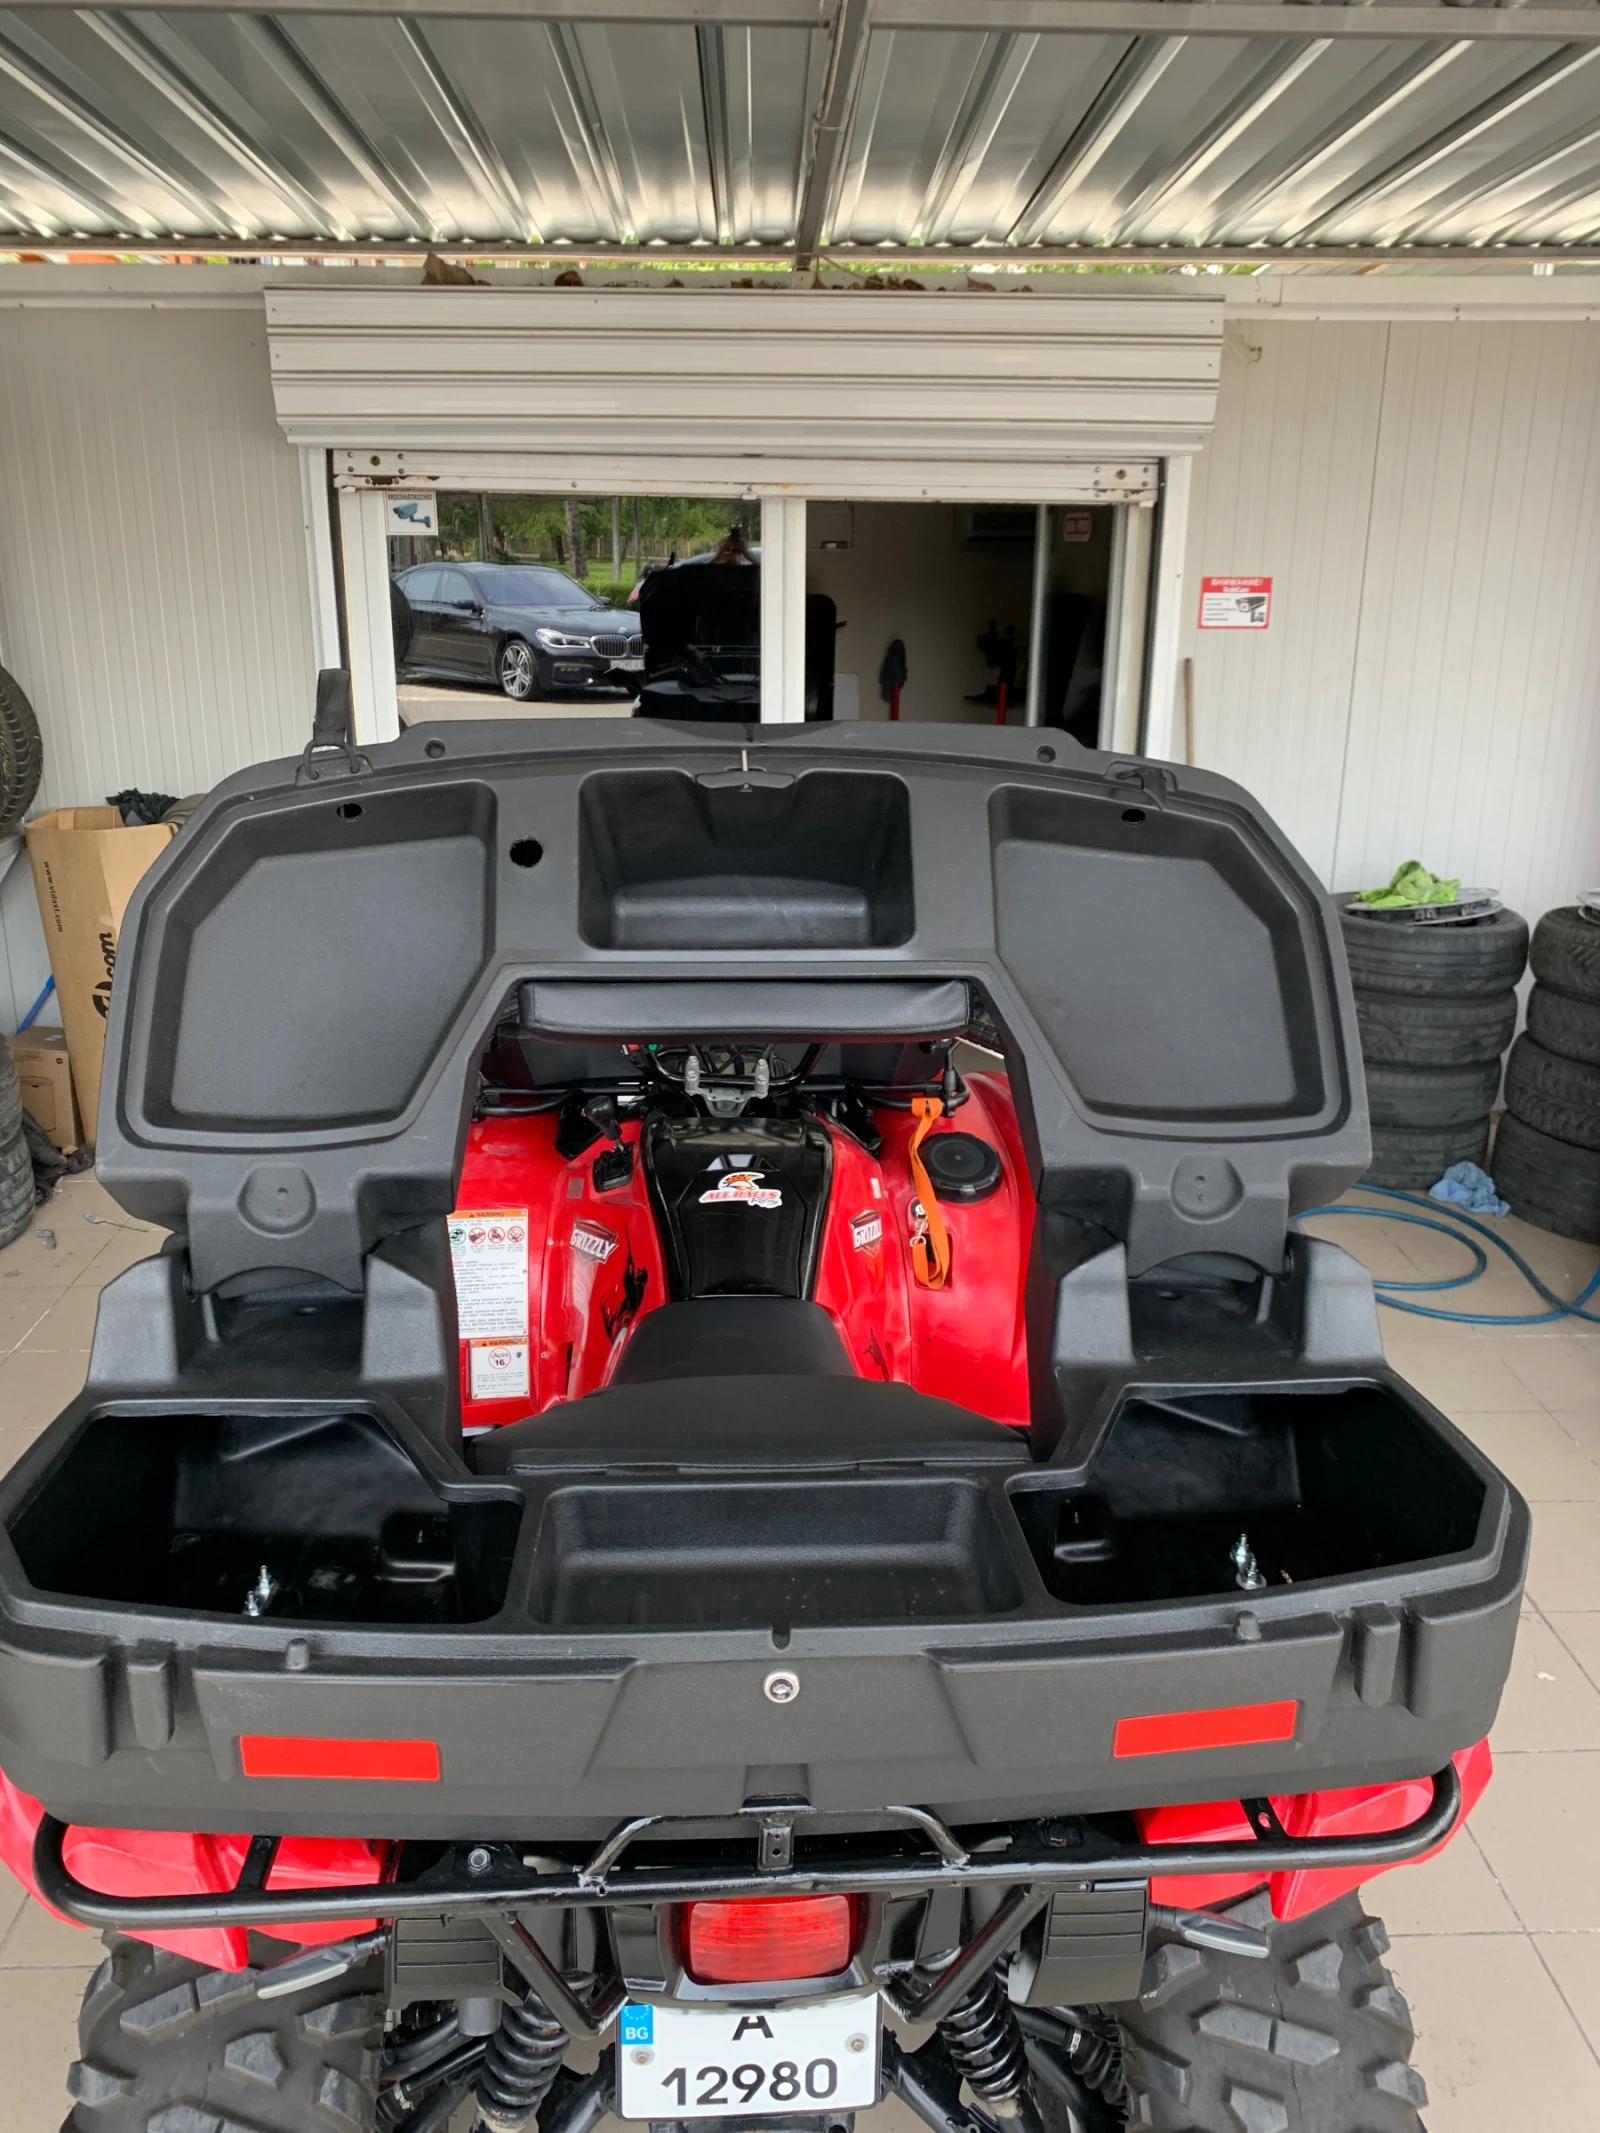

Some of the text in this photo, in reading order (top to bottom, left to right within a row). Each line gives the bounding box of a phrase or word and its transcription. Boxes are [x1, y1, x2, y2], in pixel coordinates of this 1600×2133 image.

[570, 1228, 616, 1260] GRIZZLY
[625, 2026, 649, 2040] BG
[661, 2058, 838, 2106] 12980
